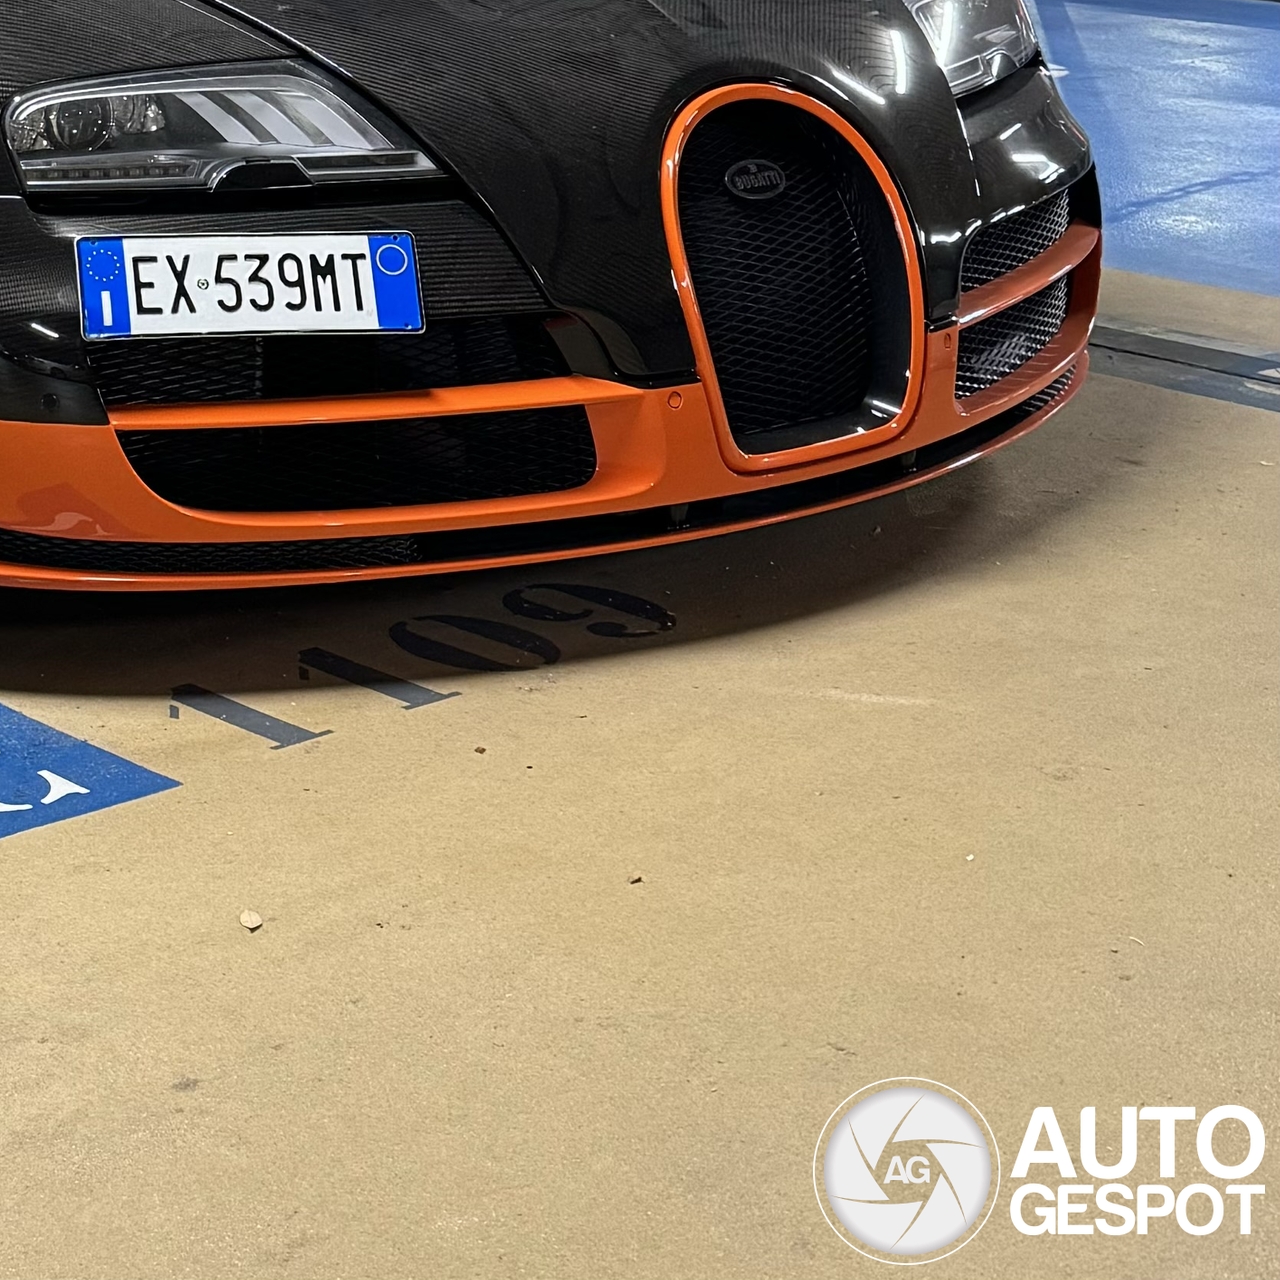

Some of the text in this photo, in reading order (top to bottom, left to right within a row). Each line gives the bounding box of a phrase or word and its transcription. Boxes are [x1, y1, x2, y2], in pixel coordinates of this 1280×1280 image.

[732, 169, 781, 190] BUGATTI
[132, 255, 196, 315] EX
[214, 253, 367, 312] 539MT
[169, 583, 677, 750] 1109
